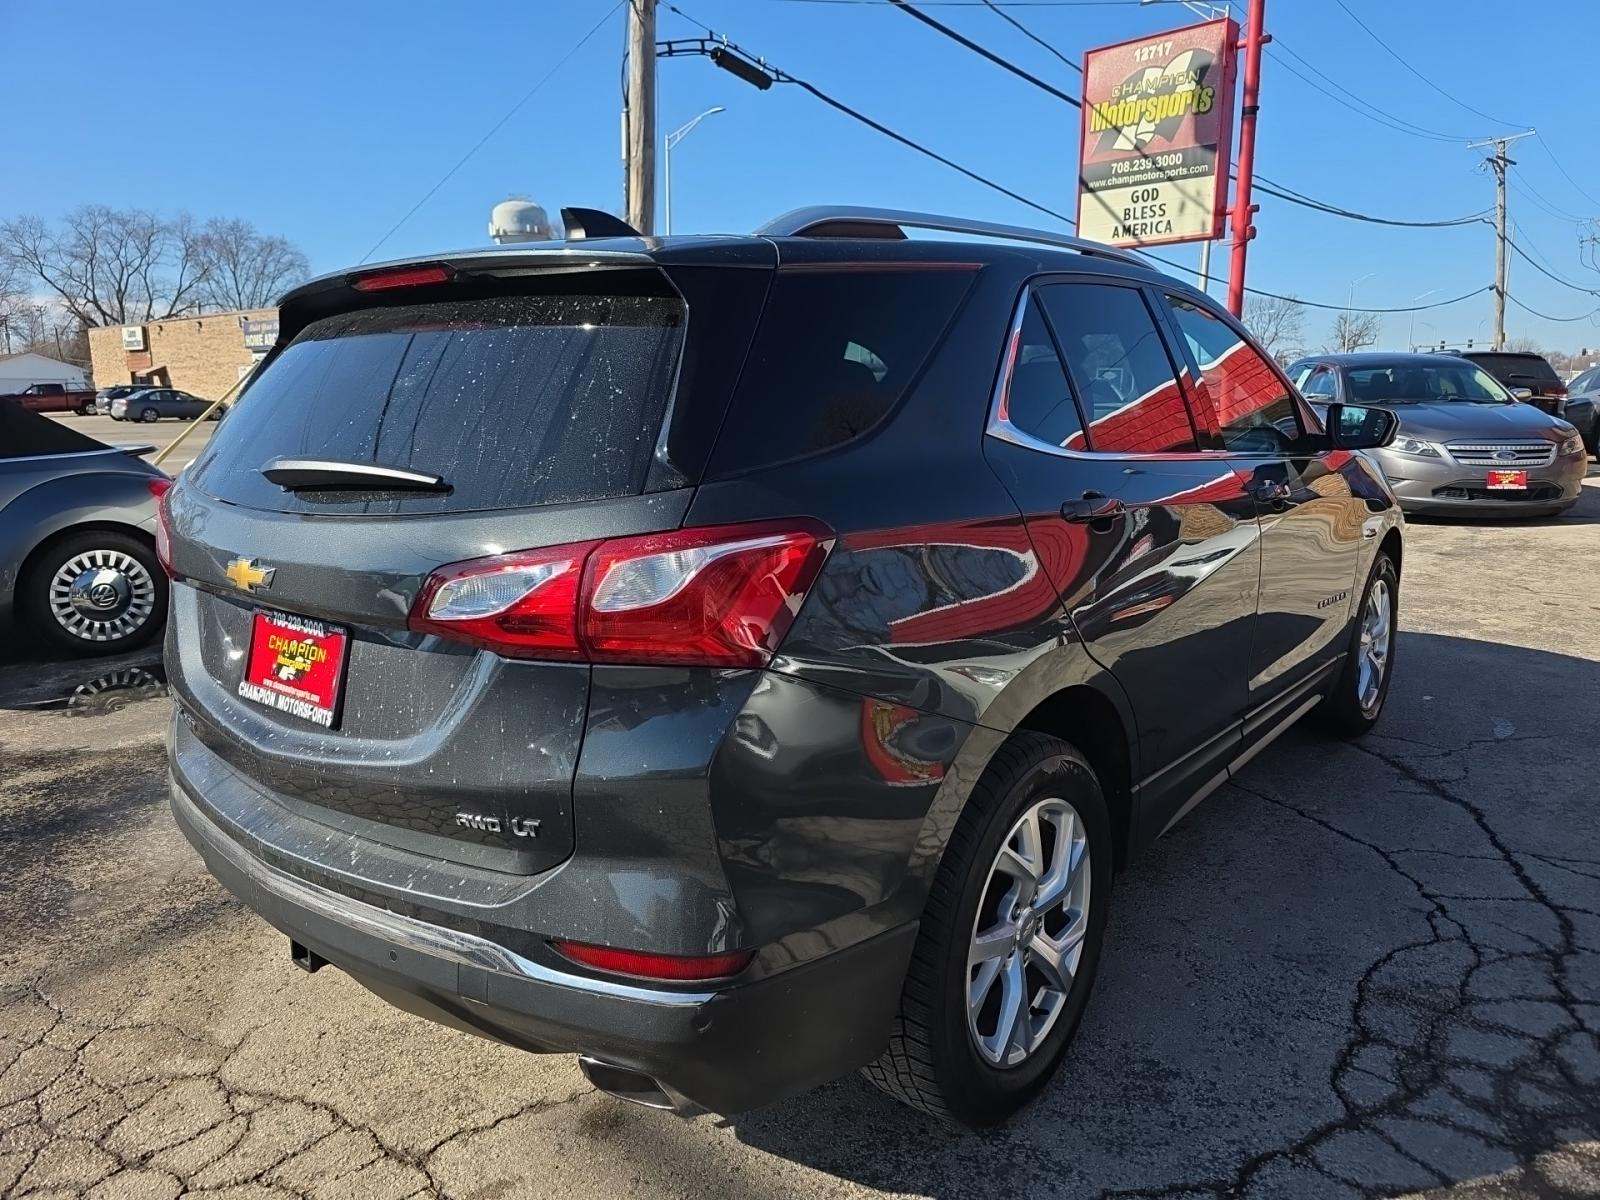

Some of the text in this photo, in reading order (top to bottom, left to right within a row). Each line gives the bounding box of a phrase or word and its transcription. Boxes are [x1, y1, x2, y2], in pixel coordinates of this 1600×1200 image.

[1133, 41, 1173, 62] 12717
[1111, 69, 1200, 97] CHAMPION
[1090, 85, 1215, 133] Motorsports
[1111, 153, 1183, 174] 708.239.3000
[1088, 164, 1208, 189] www.champmotorsports.com
[1131, 188, 1159, 203] GOD
[1123, 204, 1166, 221] BLESS
[1112, 220, 1172, 239] AMERICA
[268, 635, 327, 664] CHAMPION
[238, 682, 333, 728] CHAMPION MOTORSPORTS
[511, 818, 541, 837] LT
